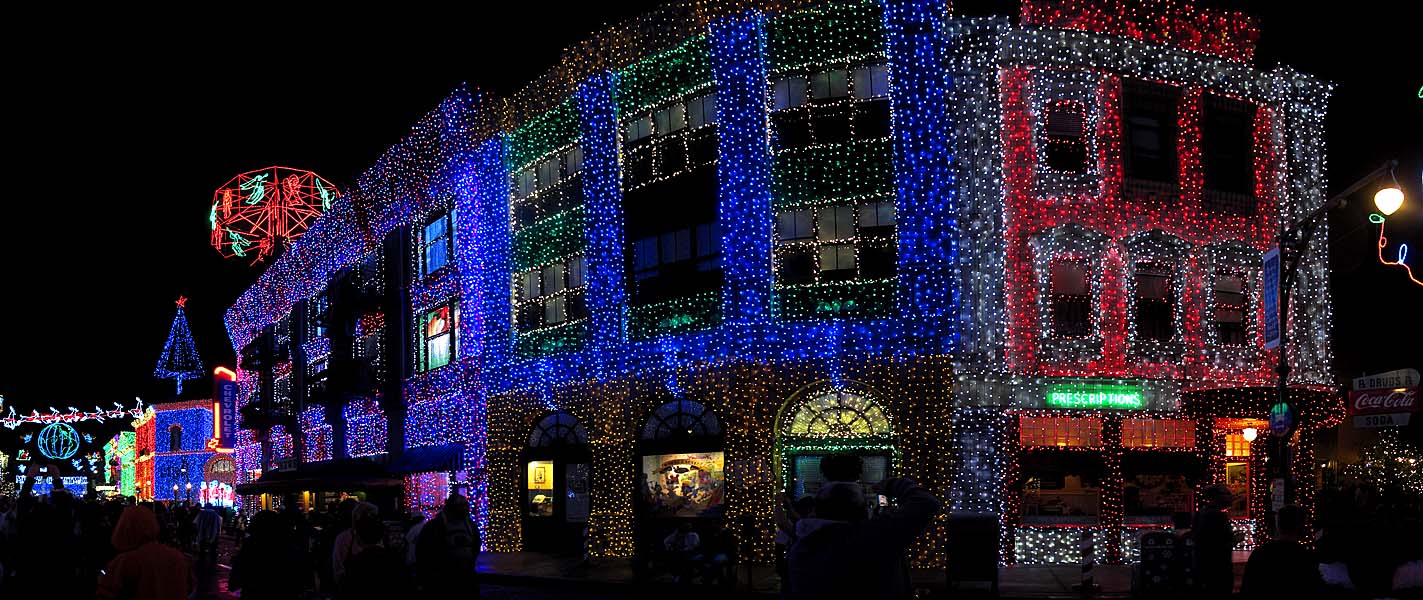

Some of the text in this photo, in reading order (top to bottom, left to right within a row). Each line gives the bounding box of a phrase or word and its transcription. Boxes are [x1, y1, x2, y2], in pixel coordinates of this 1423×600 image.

[1370, 376, 1401, 387] DRUGS
[1052, 392, 1140, 405] PRESCRIPTIONS
[223, 384, 233, 438] CHEVROLET
[1366, 415, 1393, 426] SODA
